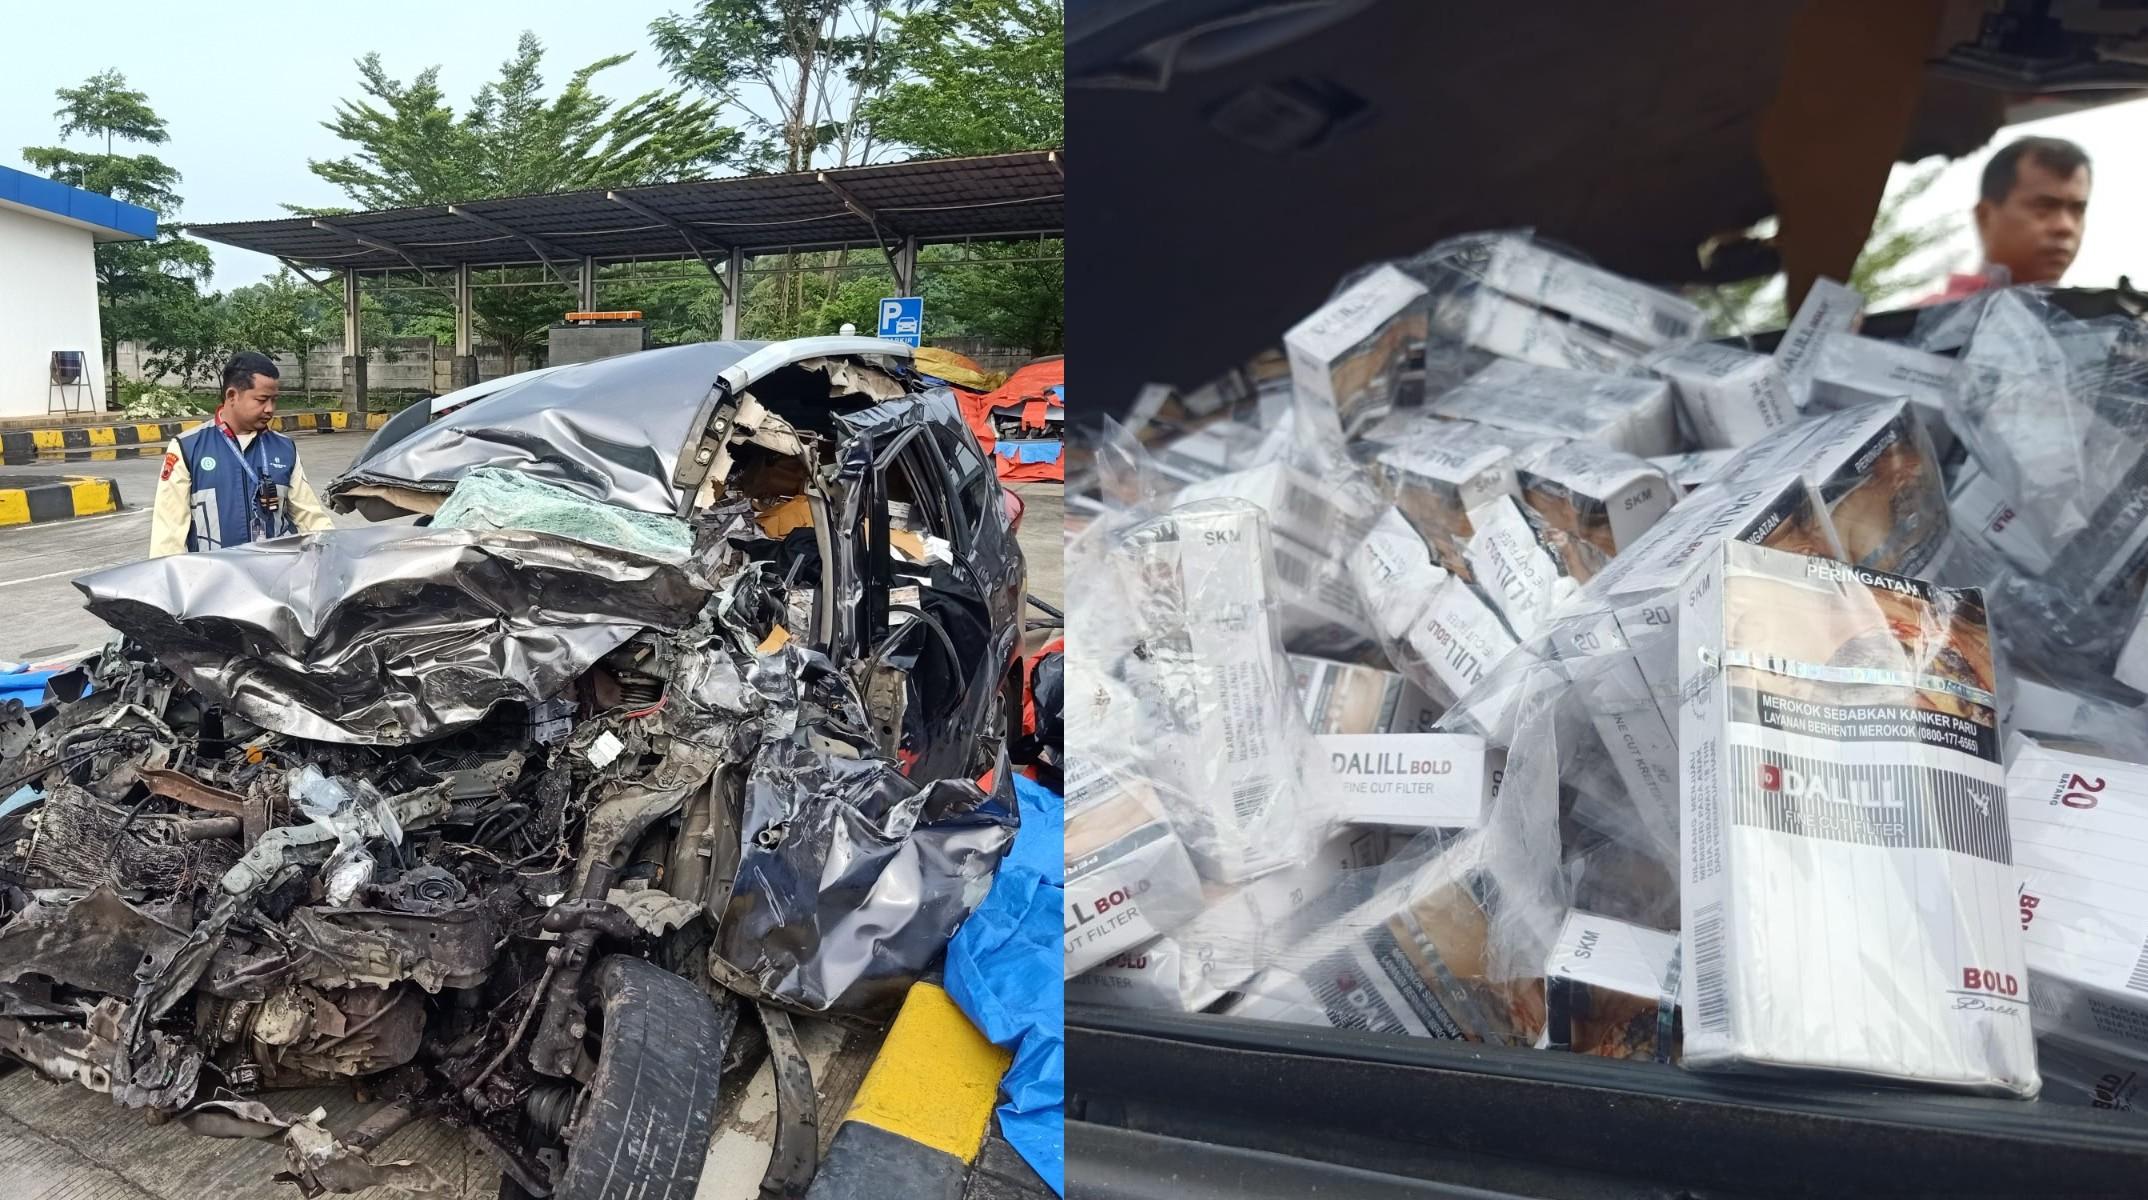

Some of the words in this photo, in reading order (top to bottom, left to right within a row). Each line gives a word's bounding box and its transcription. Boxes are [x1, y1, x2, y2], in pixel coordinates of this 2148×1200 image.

[882, 302, 902, 330] P
[1623, 488, 1654, 511] SKM
[1203, 529, 1242, 546] SKM
[1688, 573, 1711, 607] SKM
[1807, 562, 1920, 597] PERINGATAN
[1642, 605, 1671, 626] 20
[1573, 631, 1600, 651] 20
[1762, 694, 1821, 719] MEROKOK
[1823, 706, 1897, 721] SEBABKAN
[1900, 709, 1950, 729] KANKER
[1952, 718, 1977, 736] PARU
[1764, 712, 1806, 730] LAYANAN
[1808, 720, 1857, 737] BERHENTI
[1859, 725, 1917, 738] MEROKOK
[1918, 726, 1979, 754] (0800-177-6565)
[1331, 752, 1408, 775] DALILL
[1410, 760, 1453, 775] BOLD
[1343, 782, 1368, 794] FINE
[1370, 782, 1394, 794] CUT
[1396, 782, 1435, 794] FILTER
[1782, 769, 1905, 809] DALILL
[2049, 772, 2070, 807] BATANG
[2061, 773, 2106, 810] 20
[1785, 809, 1816, 826] FINE
[1819, 815, 1851, 831] CUT
[1854, 821, 1906, 837] FILTER
[1691, 818, 1699, 884] DILARANG
[1698, 821, 1706, 881] MEMBERI
[1705, 845, 1713, 878] USIA
[1713, 848, 1721, 874] DAN
[1087, 906, 1139, 942] FILTER
[2019, 894, 2041, 931] BO
[1574, 930, 1601, 959] SKM
[1962, 967, 2018, 996] BOLD
